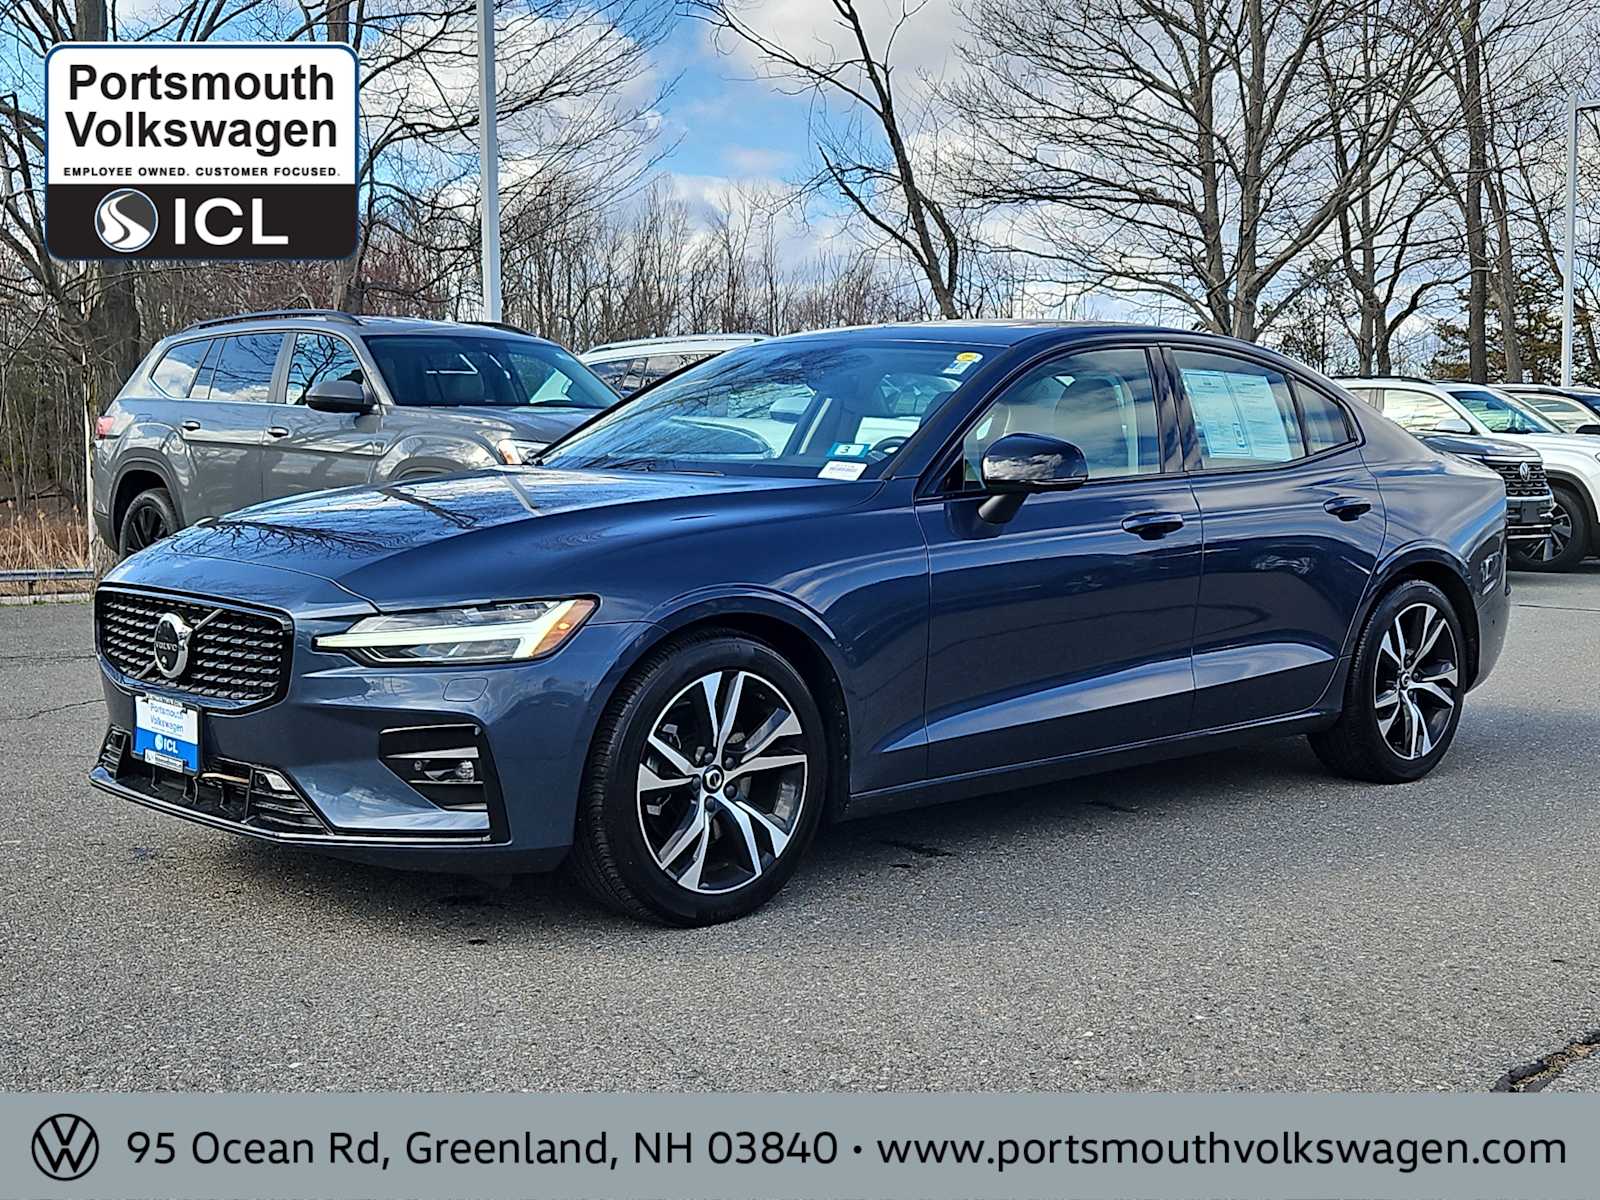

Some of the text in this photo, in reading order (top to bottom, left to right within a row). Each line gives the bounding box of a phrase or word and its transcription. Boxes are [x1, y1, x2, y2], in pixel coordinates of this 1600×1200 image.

[150, 703, 184, 720] Portsmouth
[150, 714, 184, 733] Volkswagen
[163, 738, 179, 754] ICL
